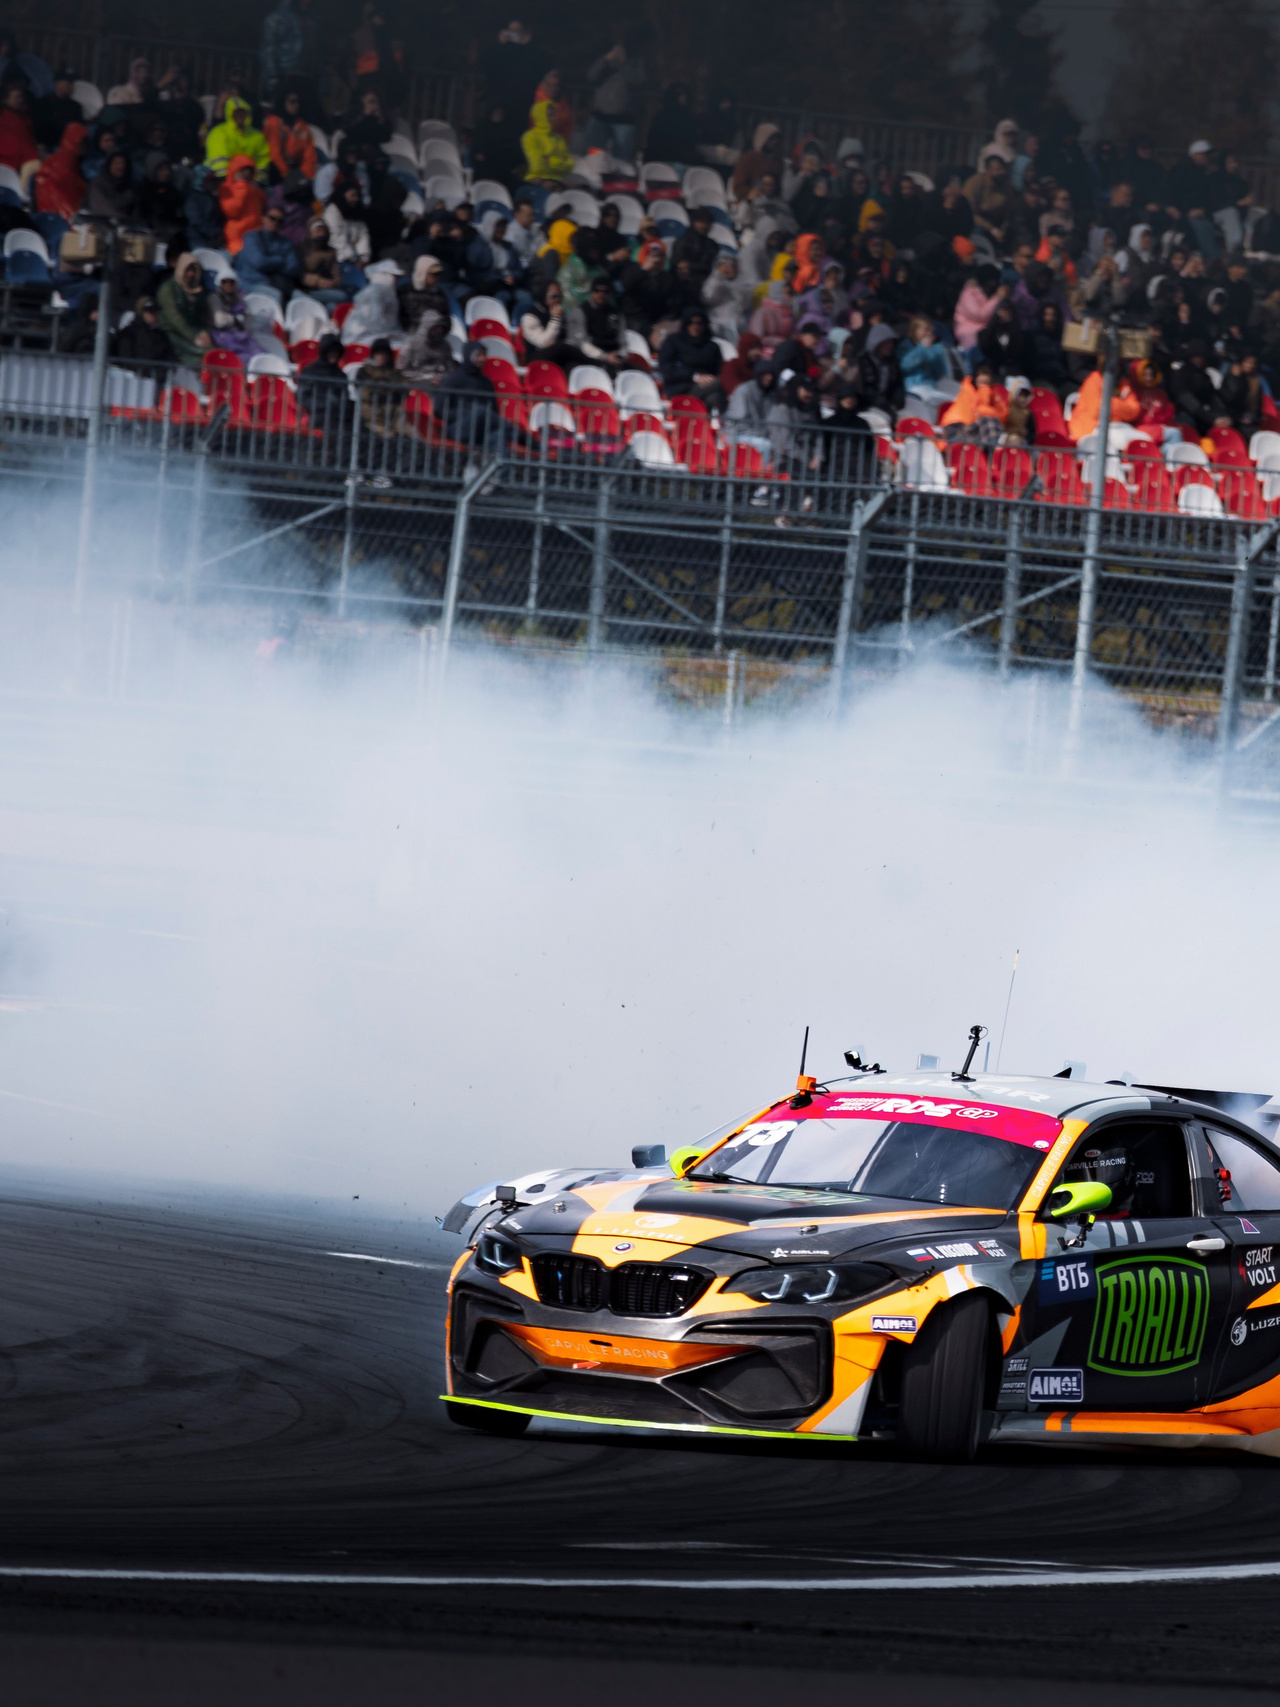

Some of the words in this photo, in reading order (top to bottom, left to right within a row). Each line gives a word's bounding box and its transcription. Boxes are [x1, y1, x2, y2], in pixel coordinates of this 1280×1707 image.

[871, 1098, 965, 1118] RDS
[956, 1106, 999, 1120] GP
[1032, 1159, 1058, 1198] CARVILLE
[1052, 1133, 1073, 1161] RACING
[1100, 1157, 1127, 1168] RACING
[1245, 1246, 1274, 1267] START
[1055, 1261, 1090, 1292] ВТБ
[1246, 1266, 1277, 1286] VOLT
[872, 1318, 916, 1330] AIMOL
[1098, 1266, 1202, 1365] TRIALLI
[545, 1337, 610, 1356] CARVILLE
[612, 1346, 669, 1360] RACING
[1030, 1375, 1081, 1395] AIMOL
